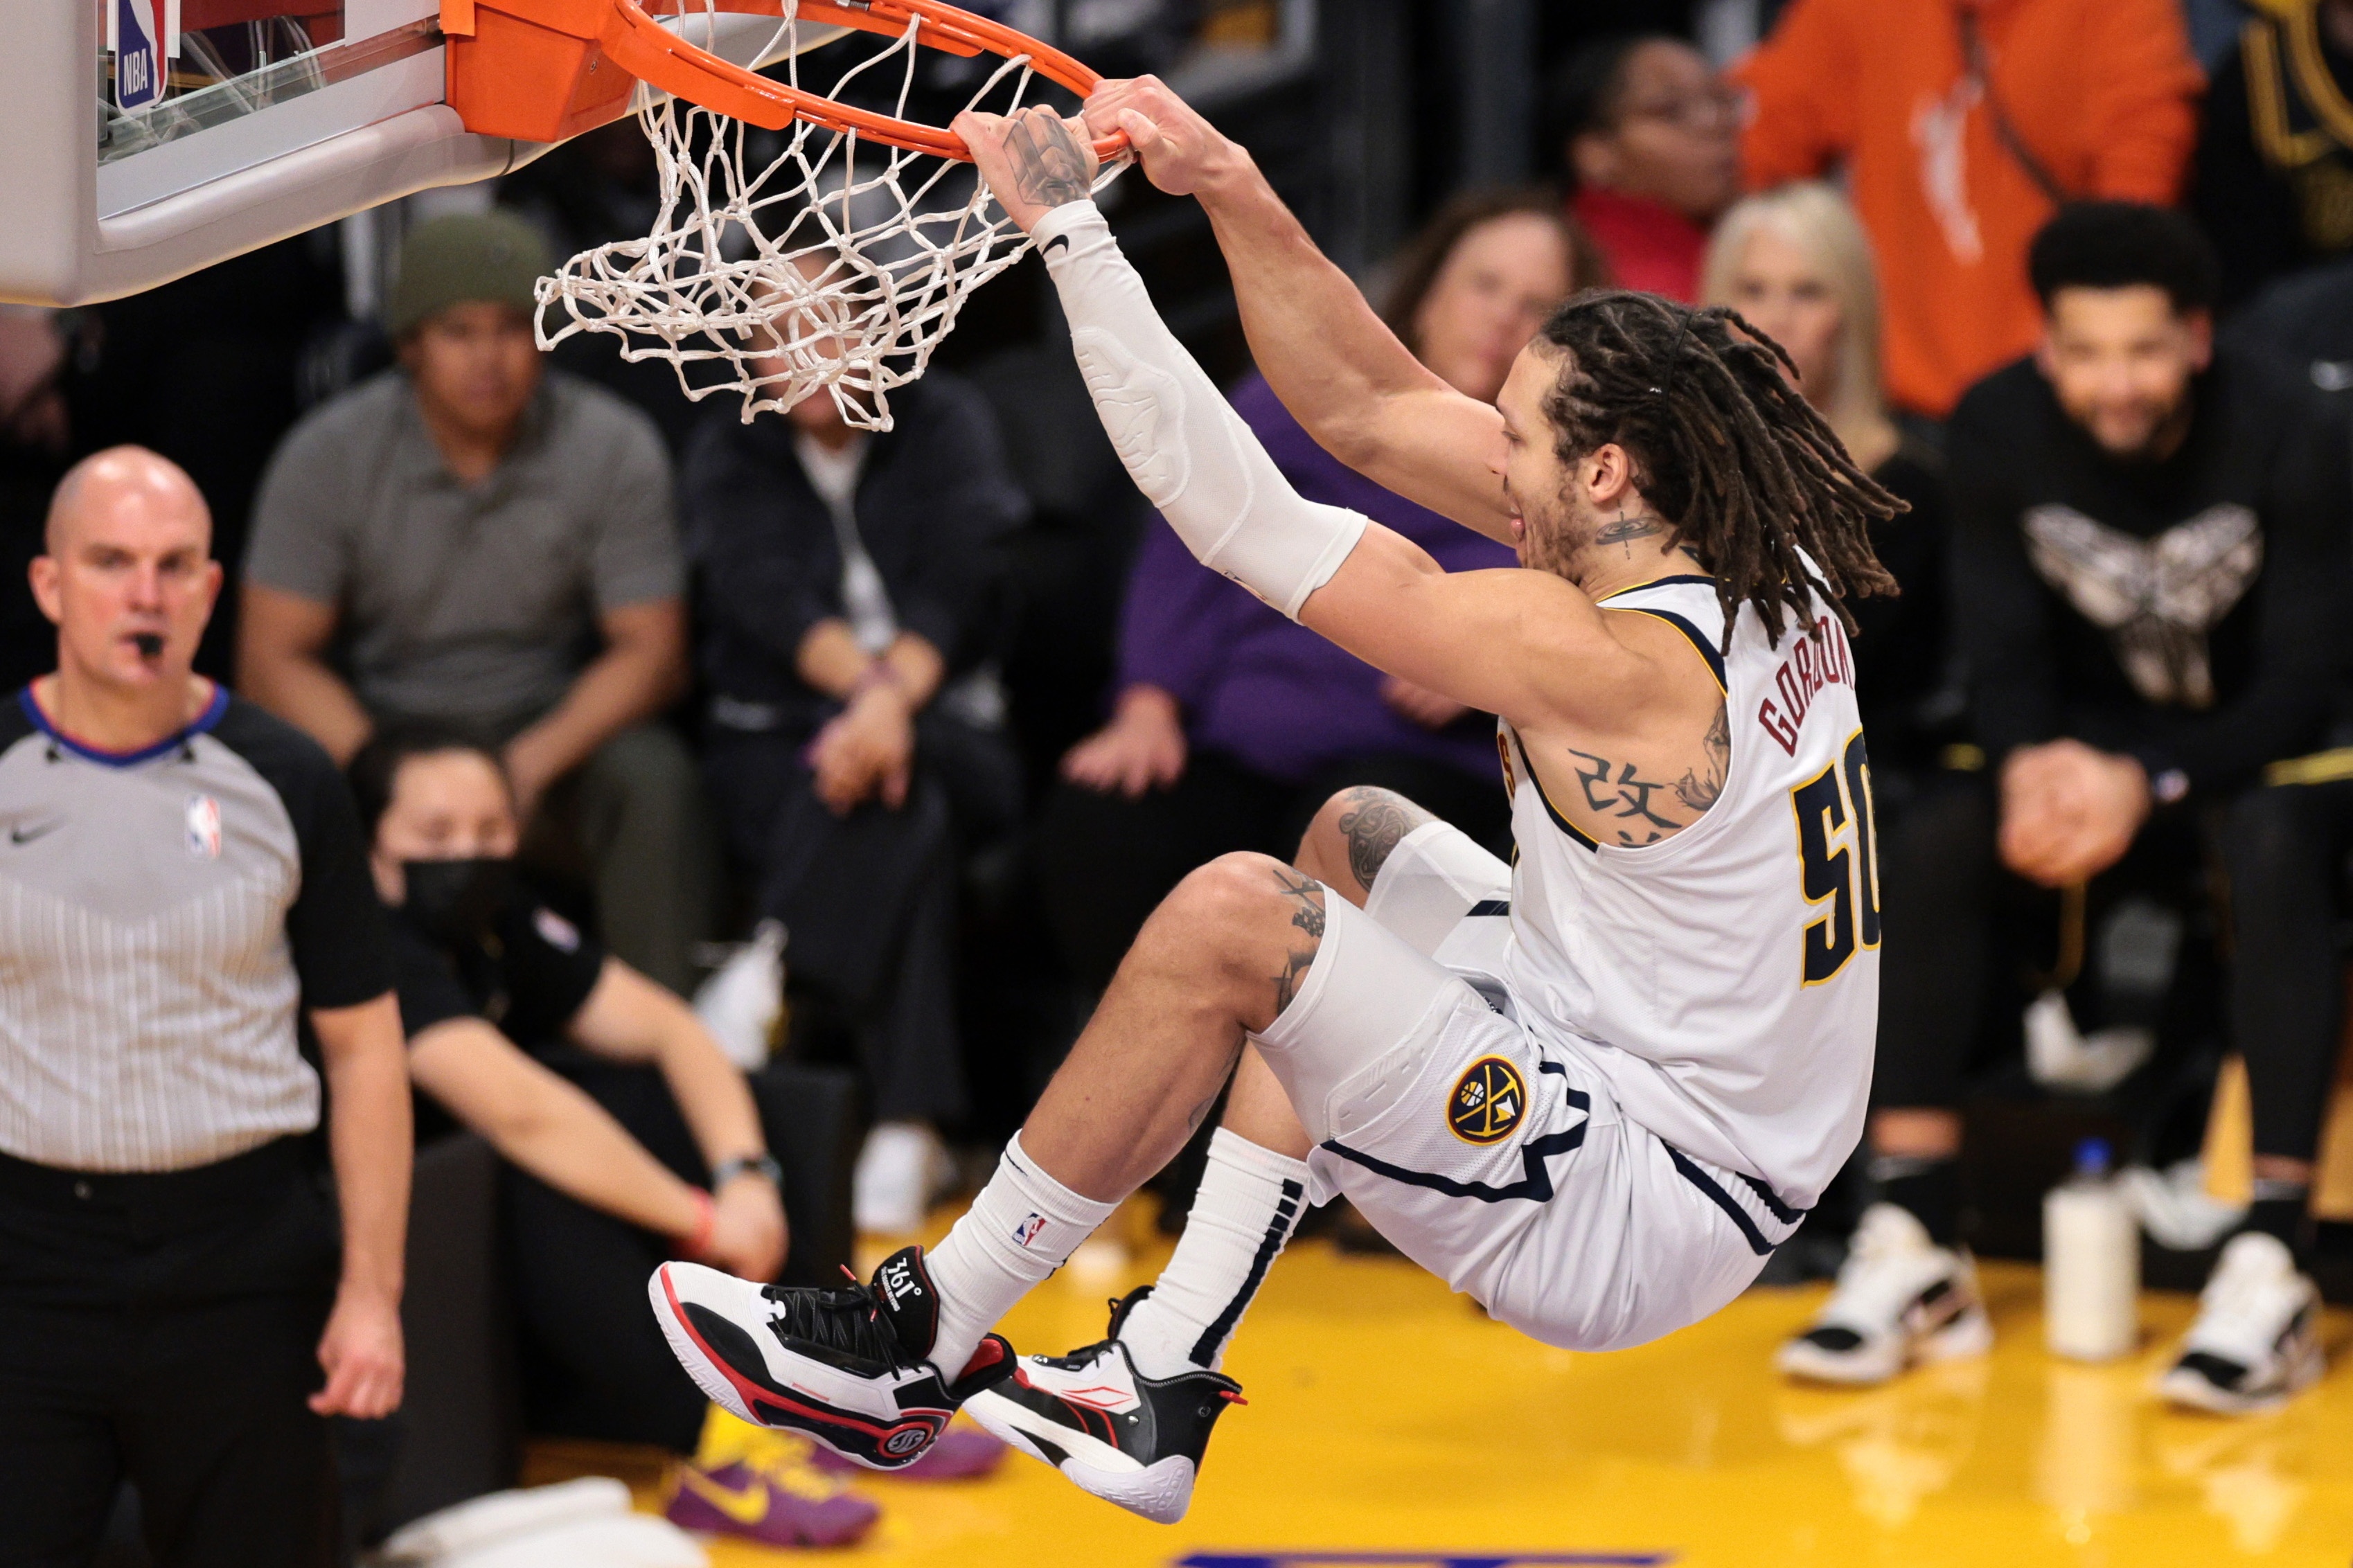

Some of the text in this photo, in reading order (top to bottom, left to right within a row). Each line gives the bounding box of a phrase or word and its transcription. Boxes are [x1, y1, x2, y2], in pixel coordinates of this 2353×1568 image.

[123, 48, 148, 97] NBA
[1758, 615, 1854, 758] GORDON
[1568, 747, 1683, 848] 改
[1789, 725, 1882, 990] 50
